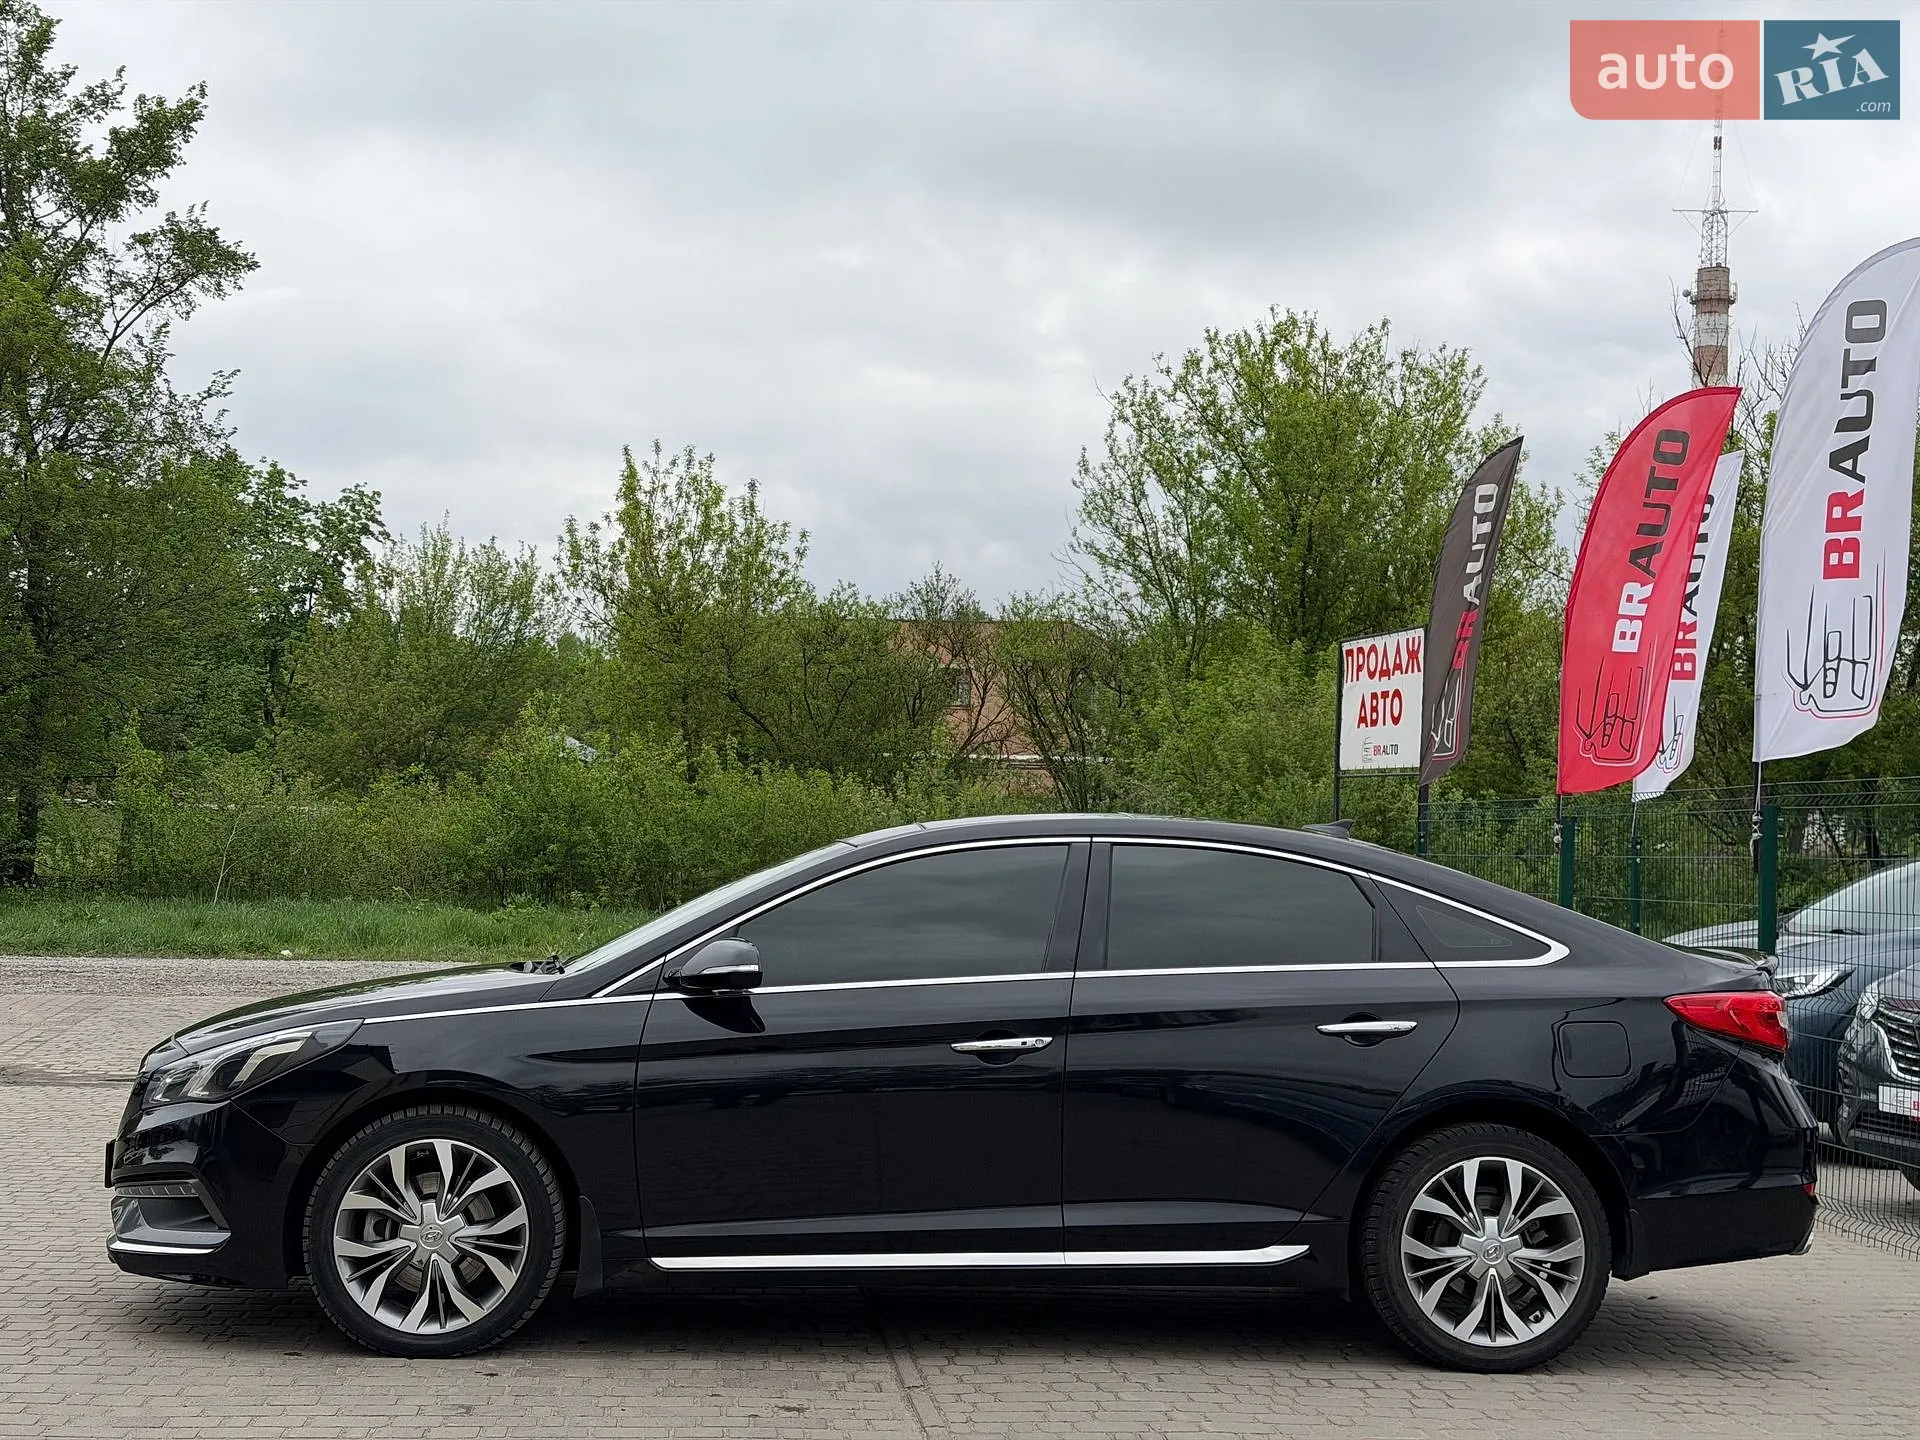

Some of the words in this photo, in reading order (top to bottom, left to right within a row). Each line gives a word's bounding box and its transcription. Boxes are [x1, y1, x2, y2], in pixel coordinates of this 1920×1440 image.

[1822, 299, 1888, 580] BRAUTO
[1611, 428, 1690, 654] BRAUTO
[1344, 635, 1422, 684] ПРОДАЖ
[1357, 688, 1403, 729] АВТО
